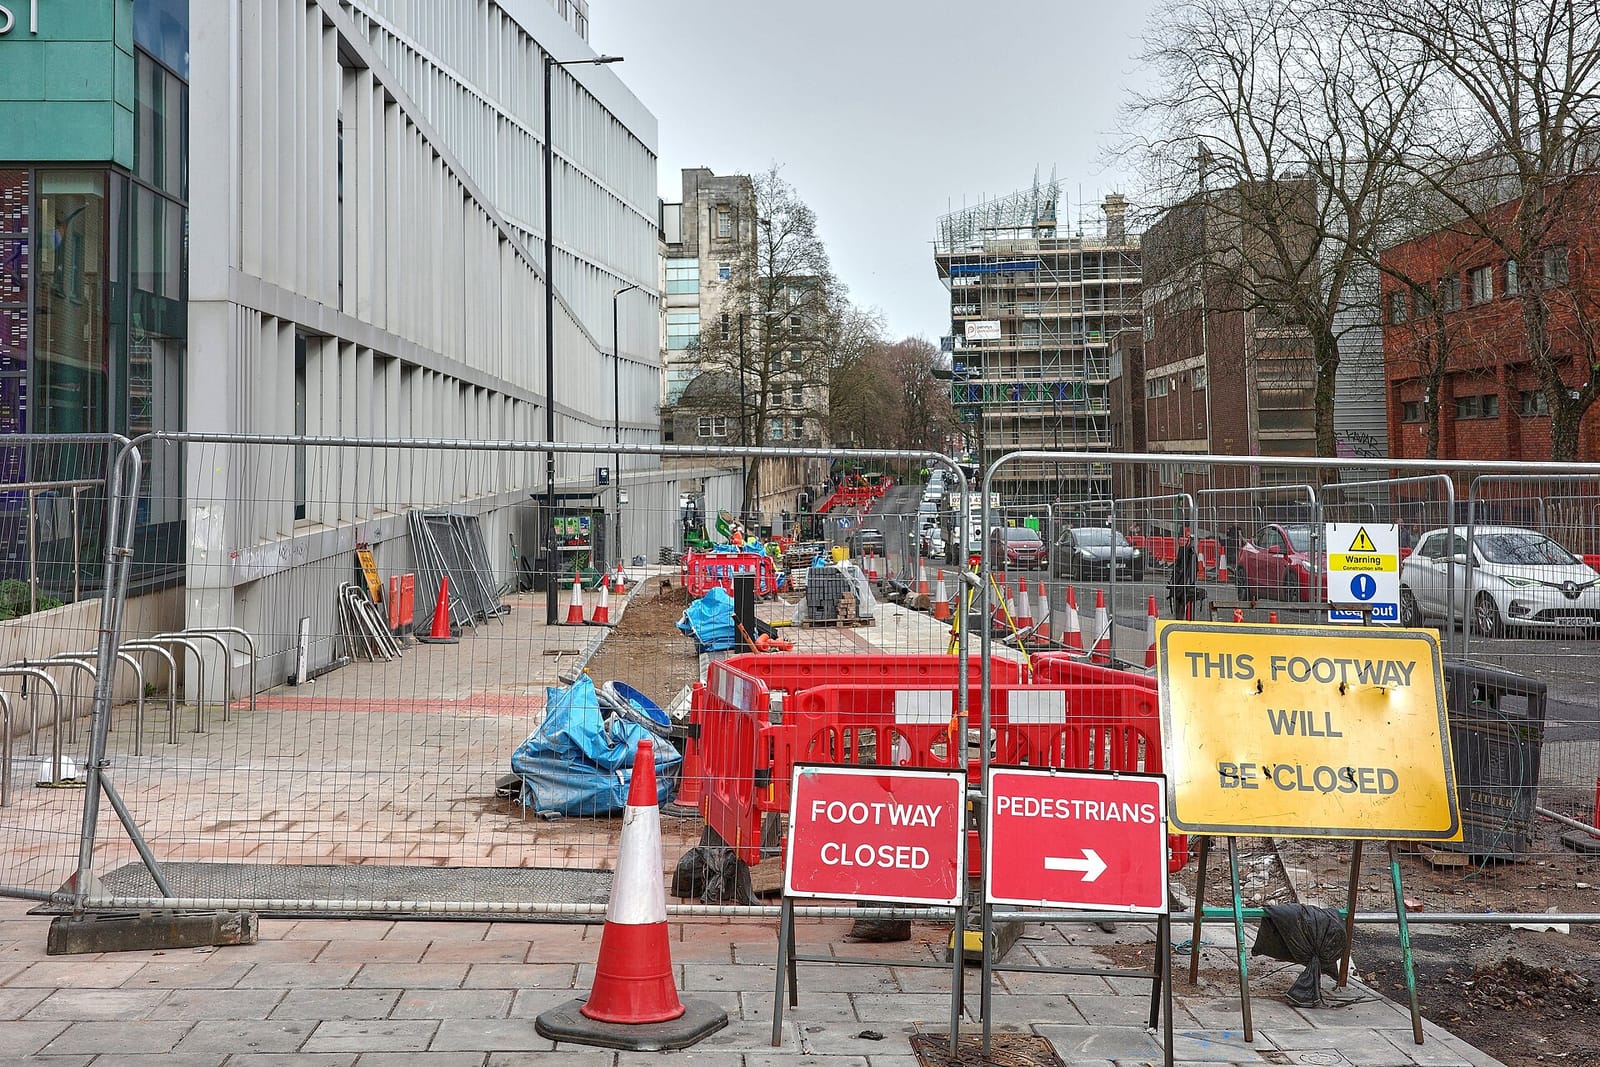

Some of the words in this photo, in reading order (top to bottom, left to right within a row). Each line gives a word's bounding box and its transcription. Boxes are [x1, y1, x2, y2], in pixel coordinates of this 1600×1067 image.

[1346, 555, 1381, 565] Warning
[1371, 605, 1394, 617] out
[1184, 652, 1255, 681] THIS
[1270, 655, 1416, 687] FOOTWAY
[1266, 708, 1344, 739] WILL
[1218, 761, 1259, 789] BE
[1272, 763, 1399, 795] CLOSED
[811, 799, 943, 828] FOOTWAY
[997, 795, 1156, 824] PEDESTRIANS
[820, 842, 930, 869] CLOSED
